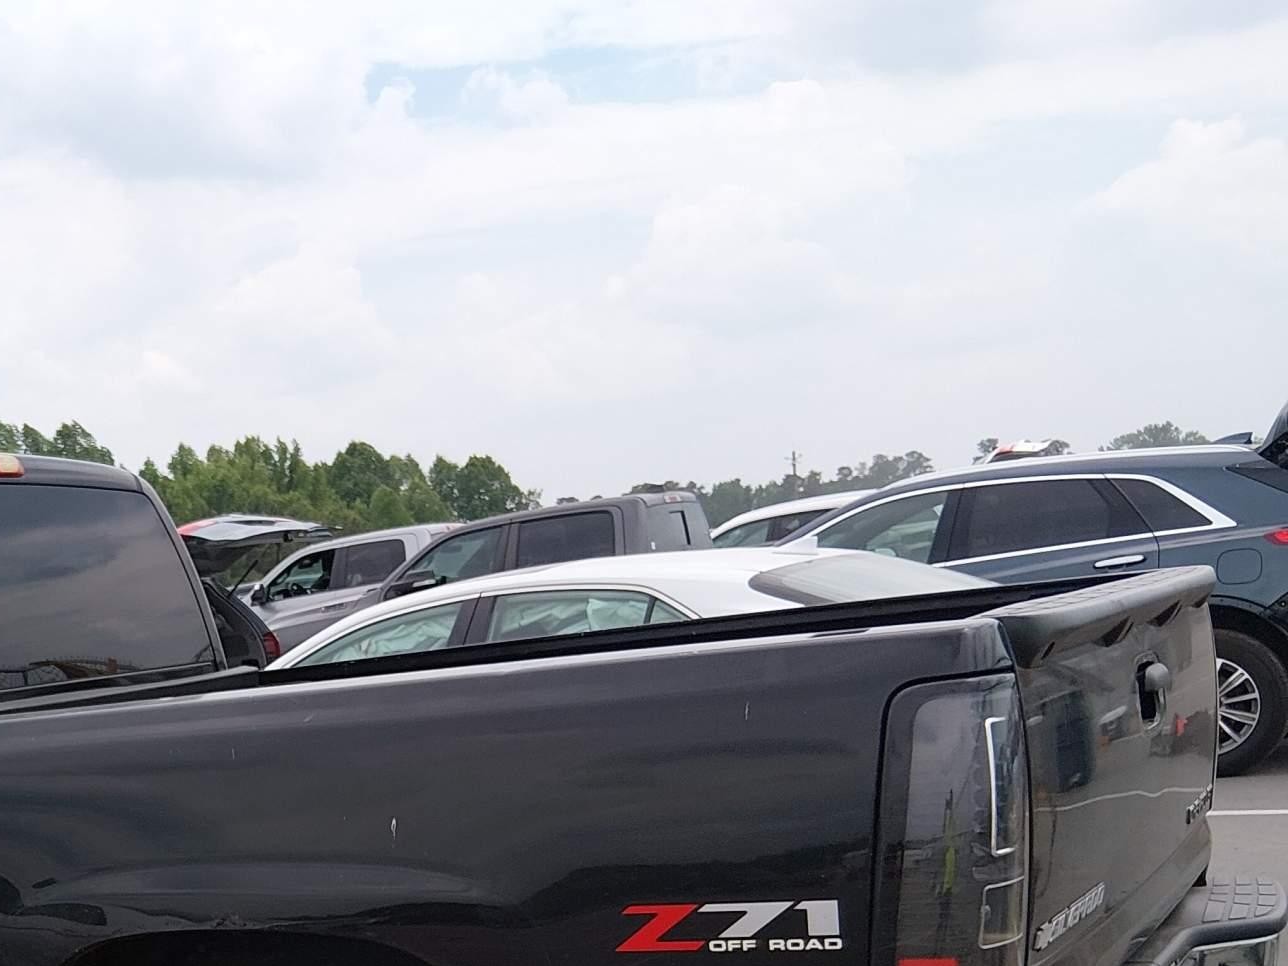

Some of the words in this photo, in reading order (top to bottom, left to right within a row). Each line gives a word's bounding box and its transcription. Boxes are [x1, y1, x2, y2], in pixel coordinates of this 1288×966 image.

[615, 899, 841, 952] Z71
[708, 938, 758, 953] OFF
[768, 937, 844, 952] ROAD
